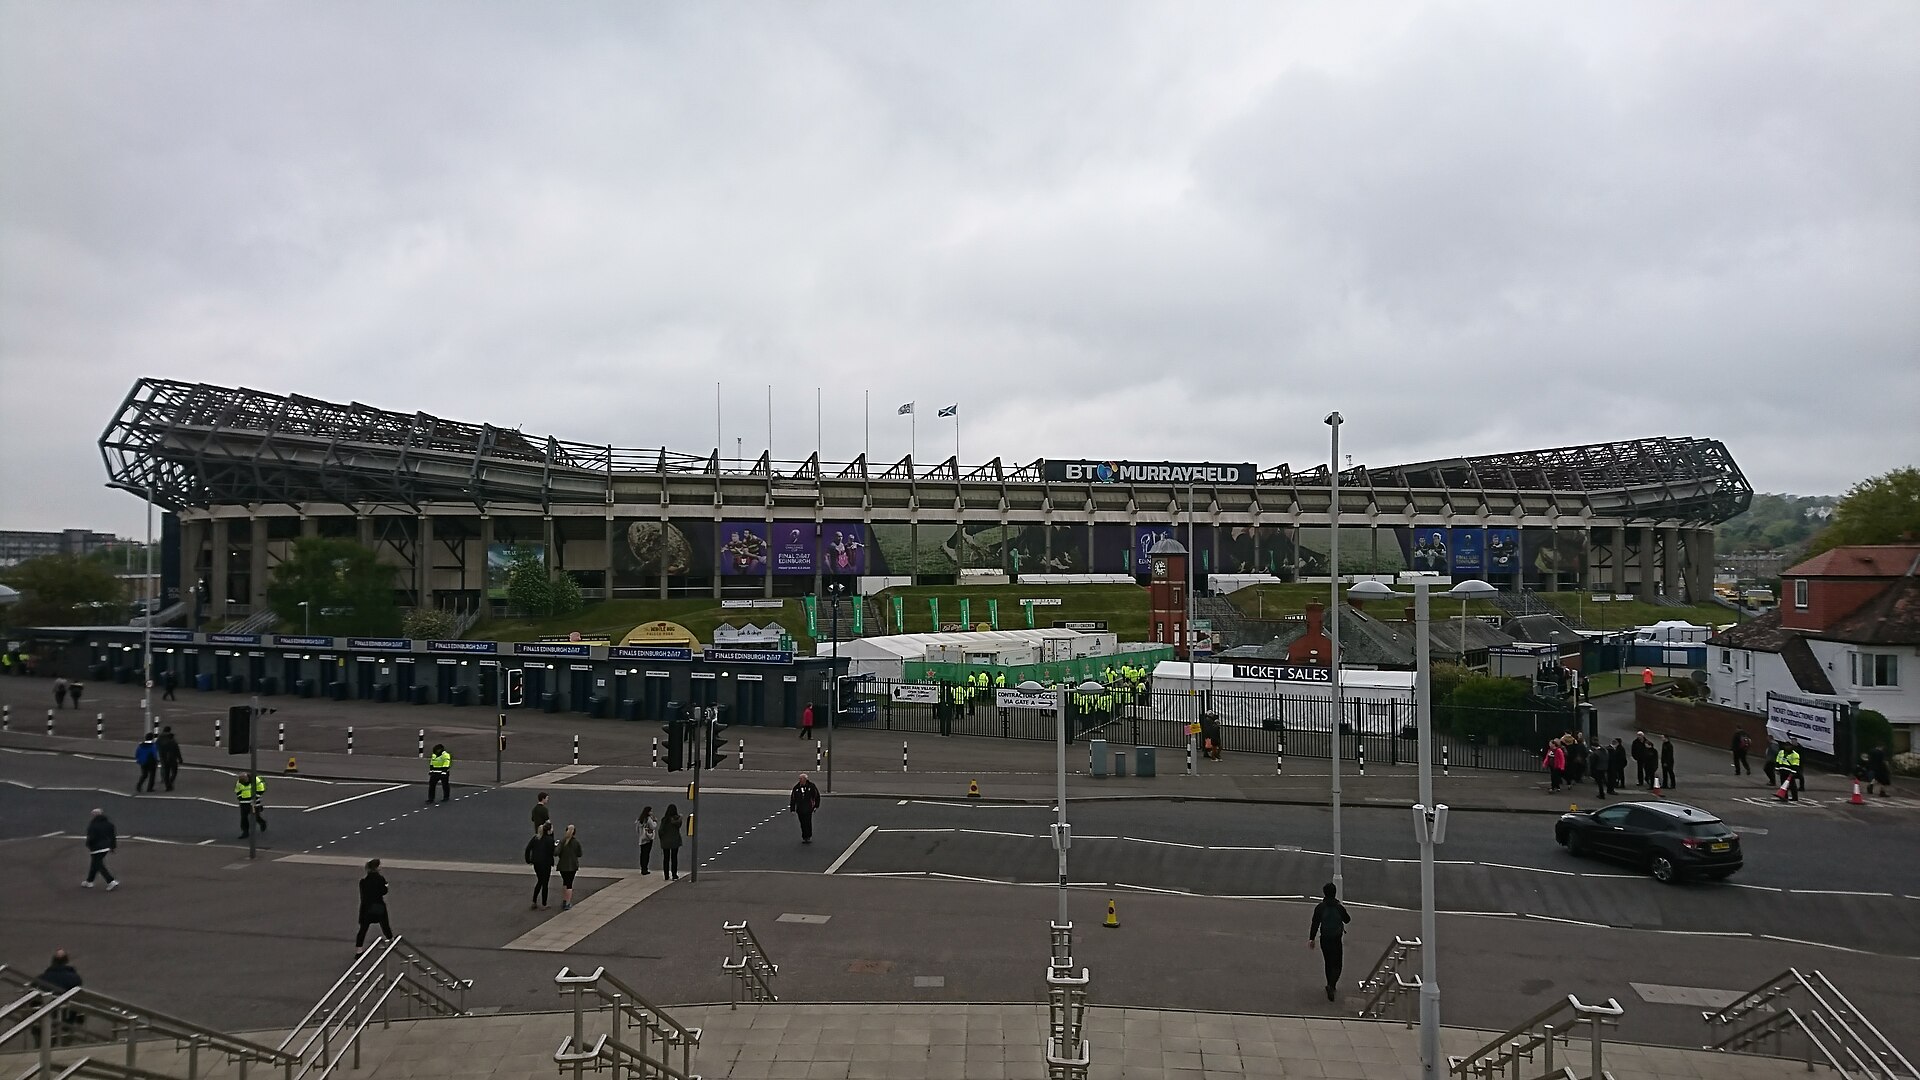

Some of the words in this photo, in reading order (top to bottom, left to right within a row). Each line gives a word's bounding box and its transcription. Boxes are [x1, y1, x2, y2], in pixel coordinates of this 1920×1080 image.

[1065, 464, 1097, 480] BT
[1120, 465, 1239, 482] MURRAYFIELD
[1237, 665, 1285, 679] TICKET
[1287, 667, 1328, 680] SALES
[997, 691, 1036, 699] CONTRACTORS
[1786, 709, 1814, 721] COLLECTIONS
[1811, 724, 1831, 734] CENTRE
